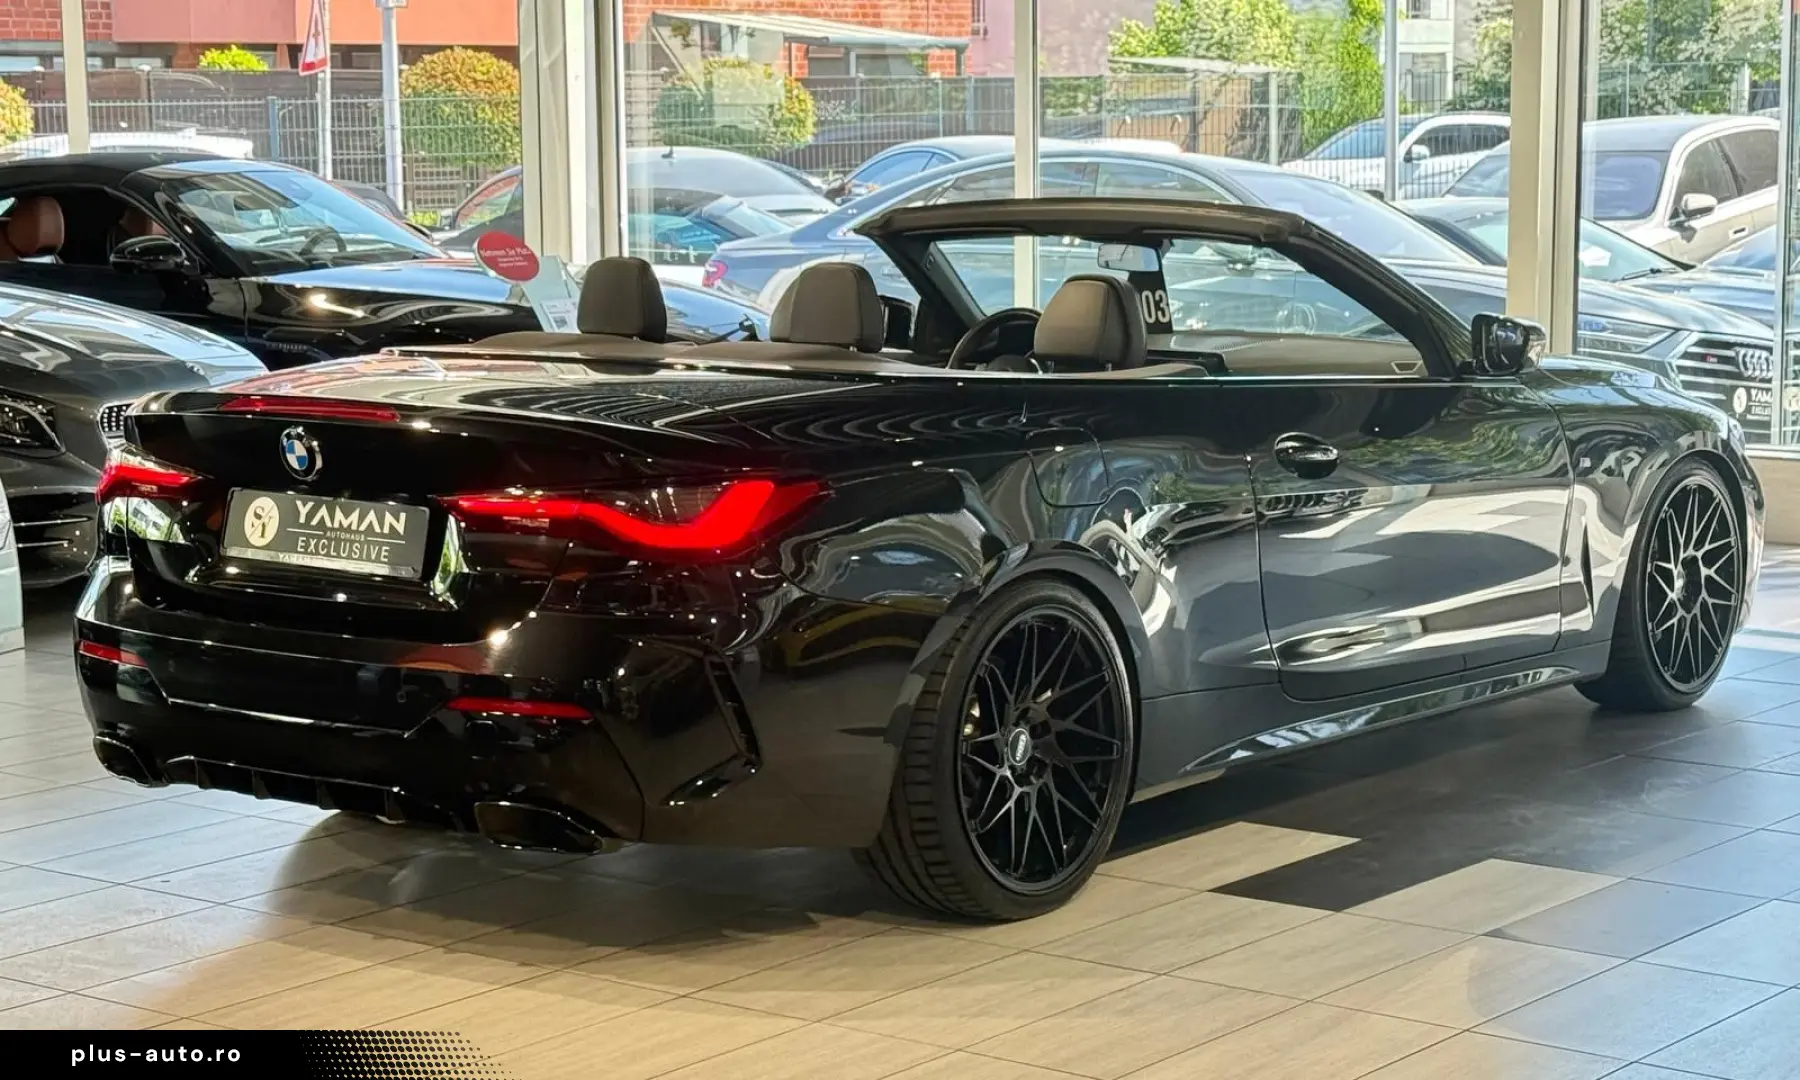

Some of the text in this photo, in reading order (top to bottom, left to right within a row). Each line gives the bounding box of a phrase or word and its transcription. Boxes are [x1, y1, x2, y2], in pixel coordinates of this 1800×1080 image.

[296, 500, 406, 535] YAMAN
[325, 531, 365, 542] AUTOHAUS
[297, 537, 390, 562] EXCLUSIVE
